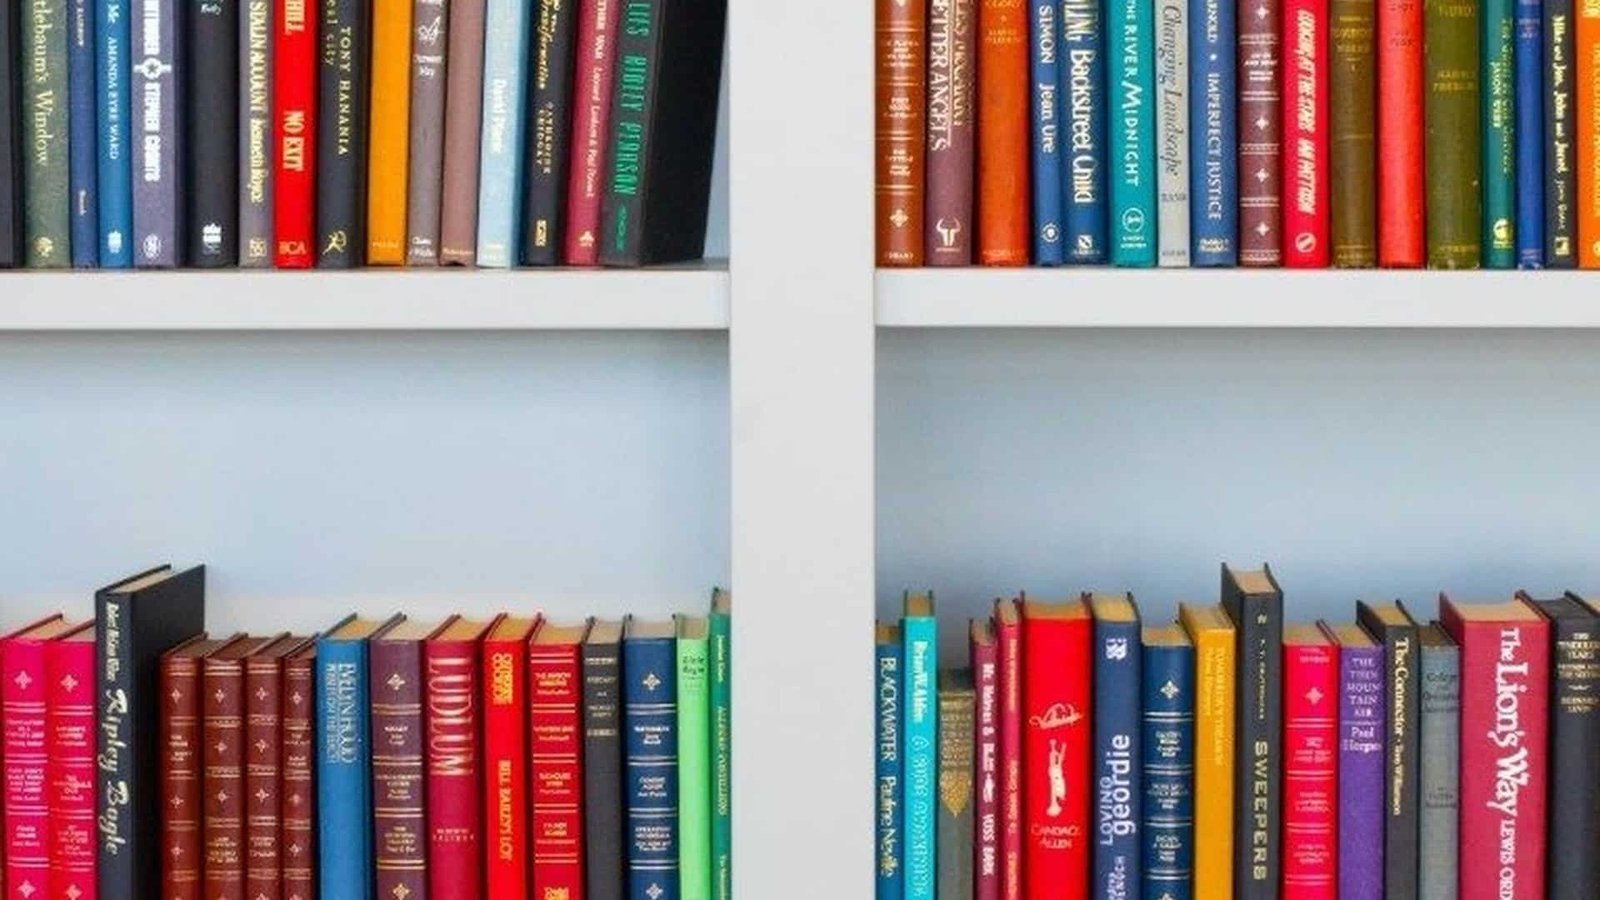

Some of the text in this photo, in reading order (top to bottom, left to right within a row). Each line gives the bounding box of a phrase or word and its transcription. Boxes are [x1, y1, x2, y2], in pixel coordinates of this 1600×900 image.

[324, 33, 337, 66] city
[1124, 25, 1138, 77] RIVER
[1157, 5, 1183, 86] Changing
[1294, 9, 1316, 57] LOOKING
[1552, 15, 1566, 44] Mike
[107, 3, 120, 160] Me AMANDA EYRE WARD
[144, 82, 160, 131] STEPHEN
[247, 1, 268, 203] STALIN ACCOUNT Kenneth Royce
[338, 26, 352, 156] TONY HANANIA
[621, 55, 649, 112] RIDLEY
[929, 72, 950, 151] ANGELS
[1038, 5, 1058, 153] SIMON Jean Ure
[1064, 0, 1099, 203] LING Backstreet Child
[34, 90, 54, 167] Window
[282, 110, 305, 134] NO
[1121, 81, 1143, 186] MIDNIGHT
[1160, 88, 1184, 177] Landscape
[1207, 73, 1221, 157] IMPERFECT
[144, 135, 161, 181] COONTS
[282, 137, 305, 172] EXIT
[614, 122, 643, 195] PEARSON
[1206, 161, 1222, 221] JUSTICE
[278, 241, 305, 256] BCA
[1351, 658, 1375, 668] THE
[1395, 637, 1409, 665] The
[1501, 627, 1521, 661] The
[428, 657, 473, 774] LUDLUM
[880, 657, 897, 761] BLACKWATER
[1346, 682, 1380, 693] MOUN
[1348, 695, 1379, 706] TAIN
[1395, 667, 1409, 737] Connector
[1487, 662, 1529, 747] Lion's
[98, 689, 128, 772] Ripley
[1350, 726, 1375, 738] Paul
[498, 760, 514, 861] BILL BAILEY'S LOT
[880, 776, 897, 826] Pauline
[1100, 777, 1115, 846] LOVING
[1106, 734, 1136, 836] geordie
[1253, 740, 1269, 881] SWEEPERS
[1486, 746, 1531, 817] Way
[99, 780, 129, 855] Bogle
[982, 813, 996, 876] VOSS BARK
[1500, 819, 1516, 864] LEWIS
